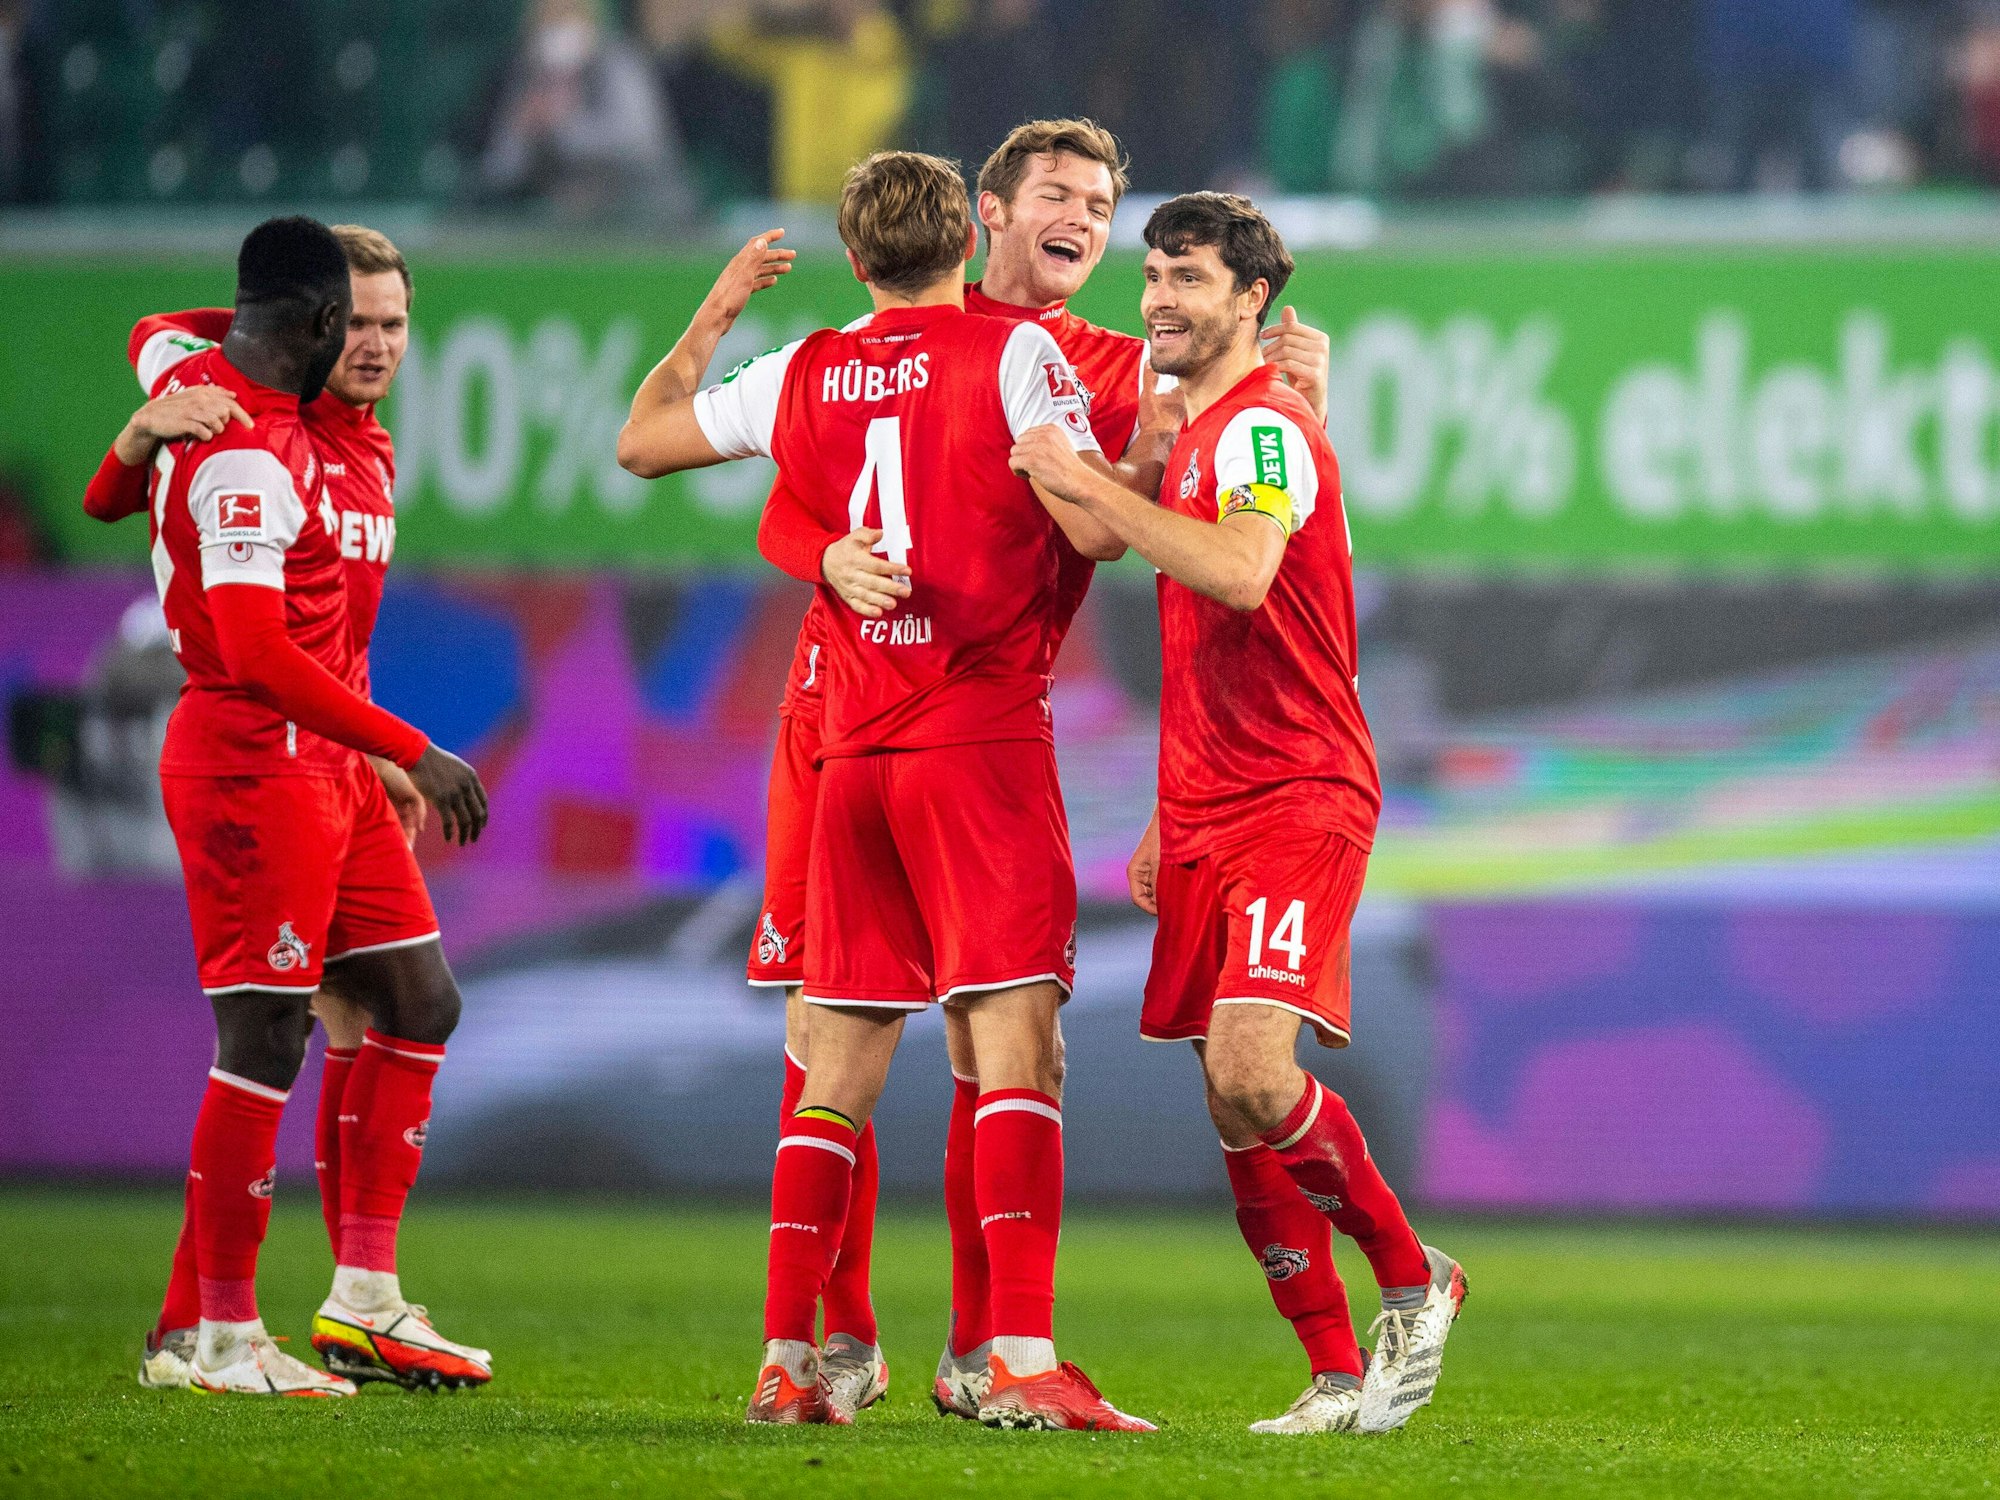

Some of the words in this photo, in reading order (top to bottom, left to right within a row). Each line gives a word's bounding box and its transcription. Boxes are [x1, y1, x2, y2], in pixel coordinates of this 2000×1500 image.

[1258, 432, 1282, 487] DEVK
[848, 416, 914, 592] 4
[219, 530, 262, 538] BUNDESLIGA
[860, 619, 888, 643] FC
[1245, 896, 1307, 971] 14
[1248, 965, 1306, 988] uhlsport
